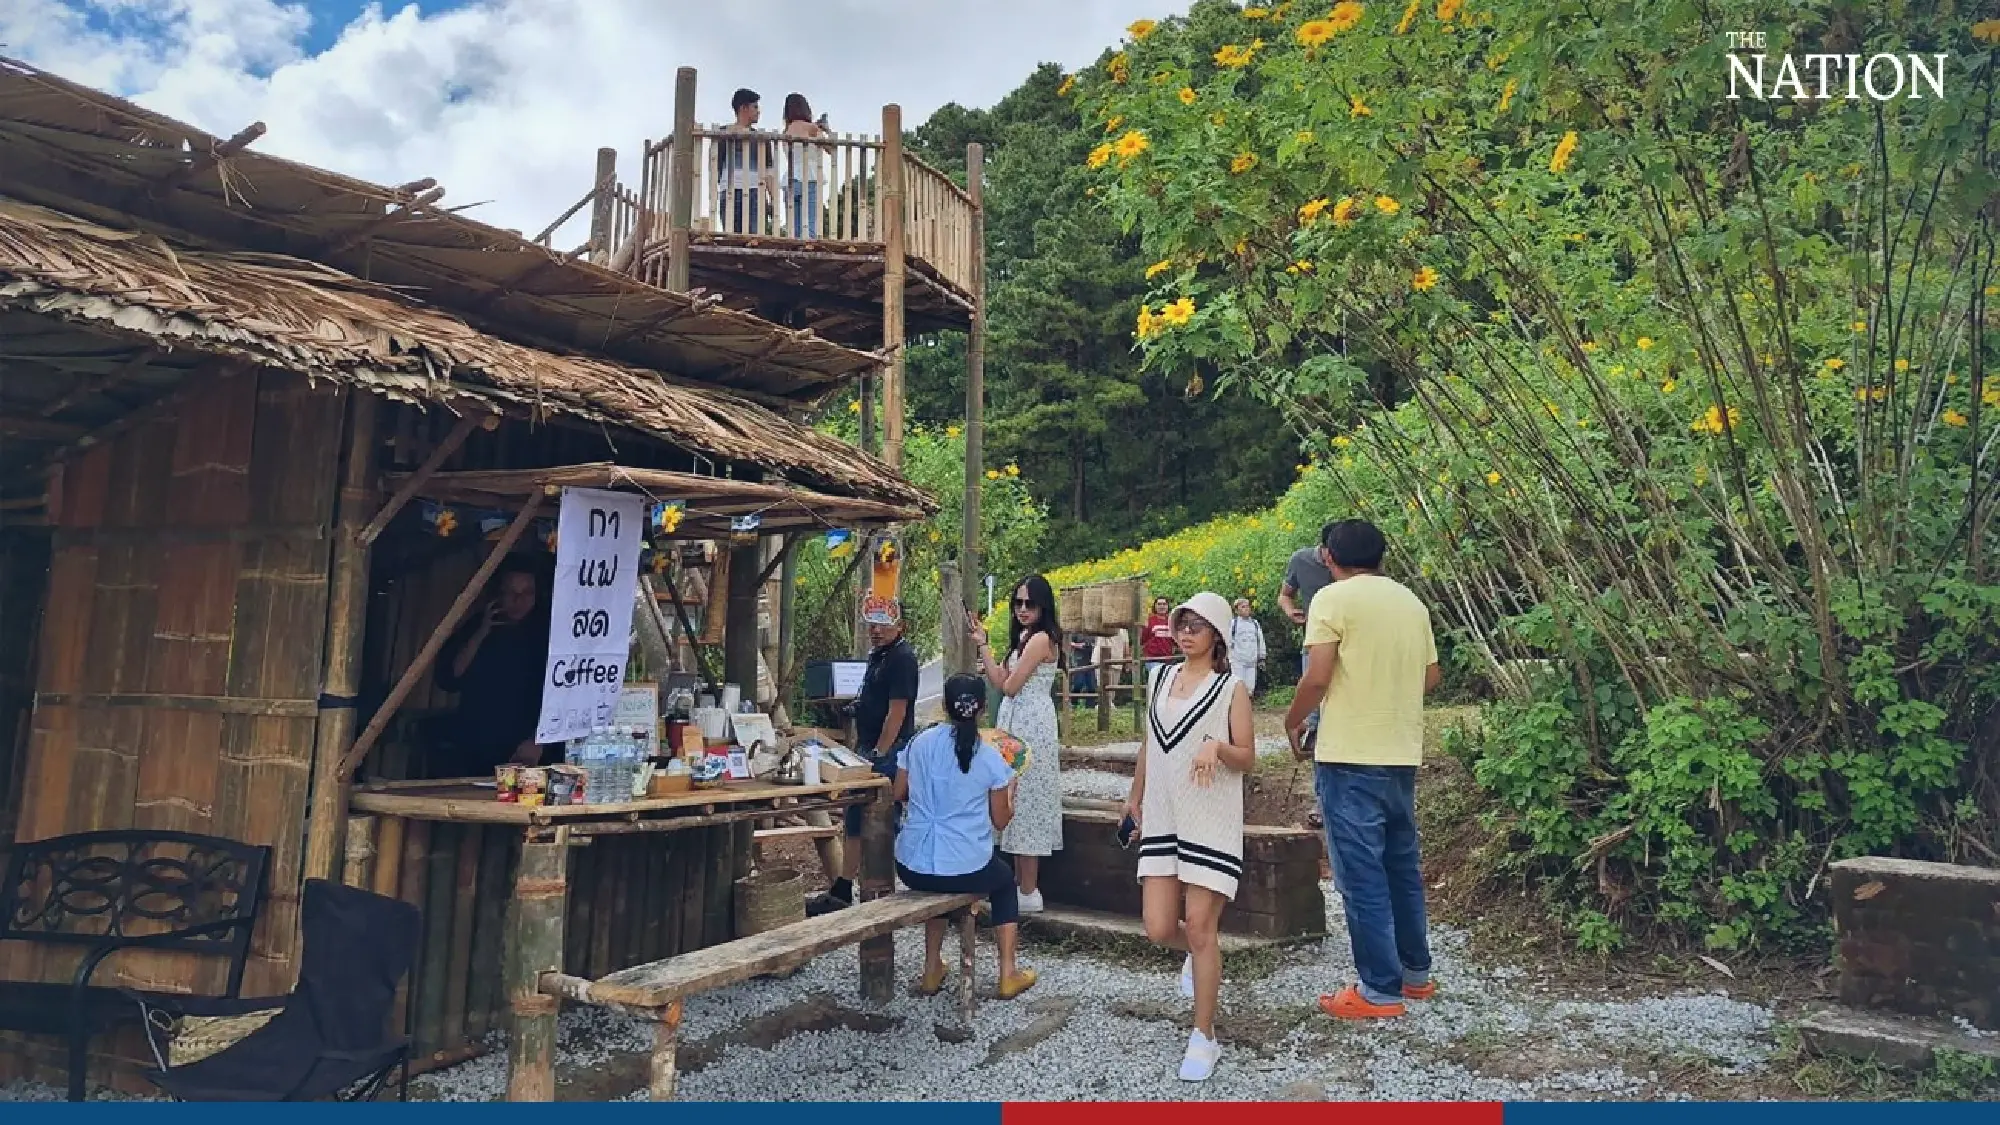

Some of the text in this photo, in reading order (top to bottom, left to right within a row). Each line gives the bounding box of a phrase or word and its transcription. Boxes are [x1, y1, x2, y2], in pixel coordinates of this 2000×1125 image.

[588, 508, 619, 539] กา
[578, 554, 618, 587] แฟ
[573, 608, 609, 638] สด
[552, 657, 619, 688] Coffee
